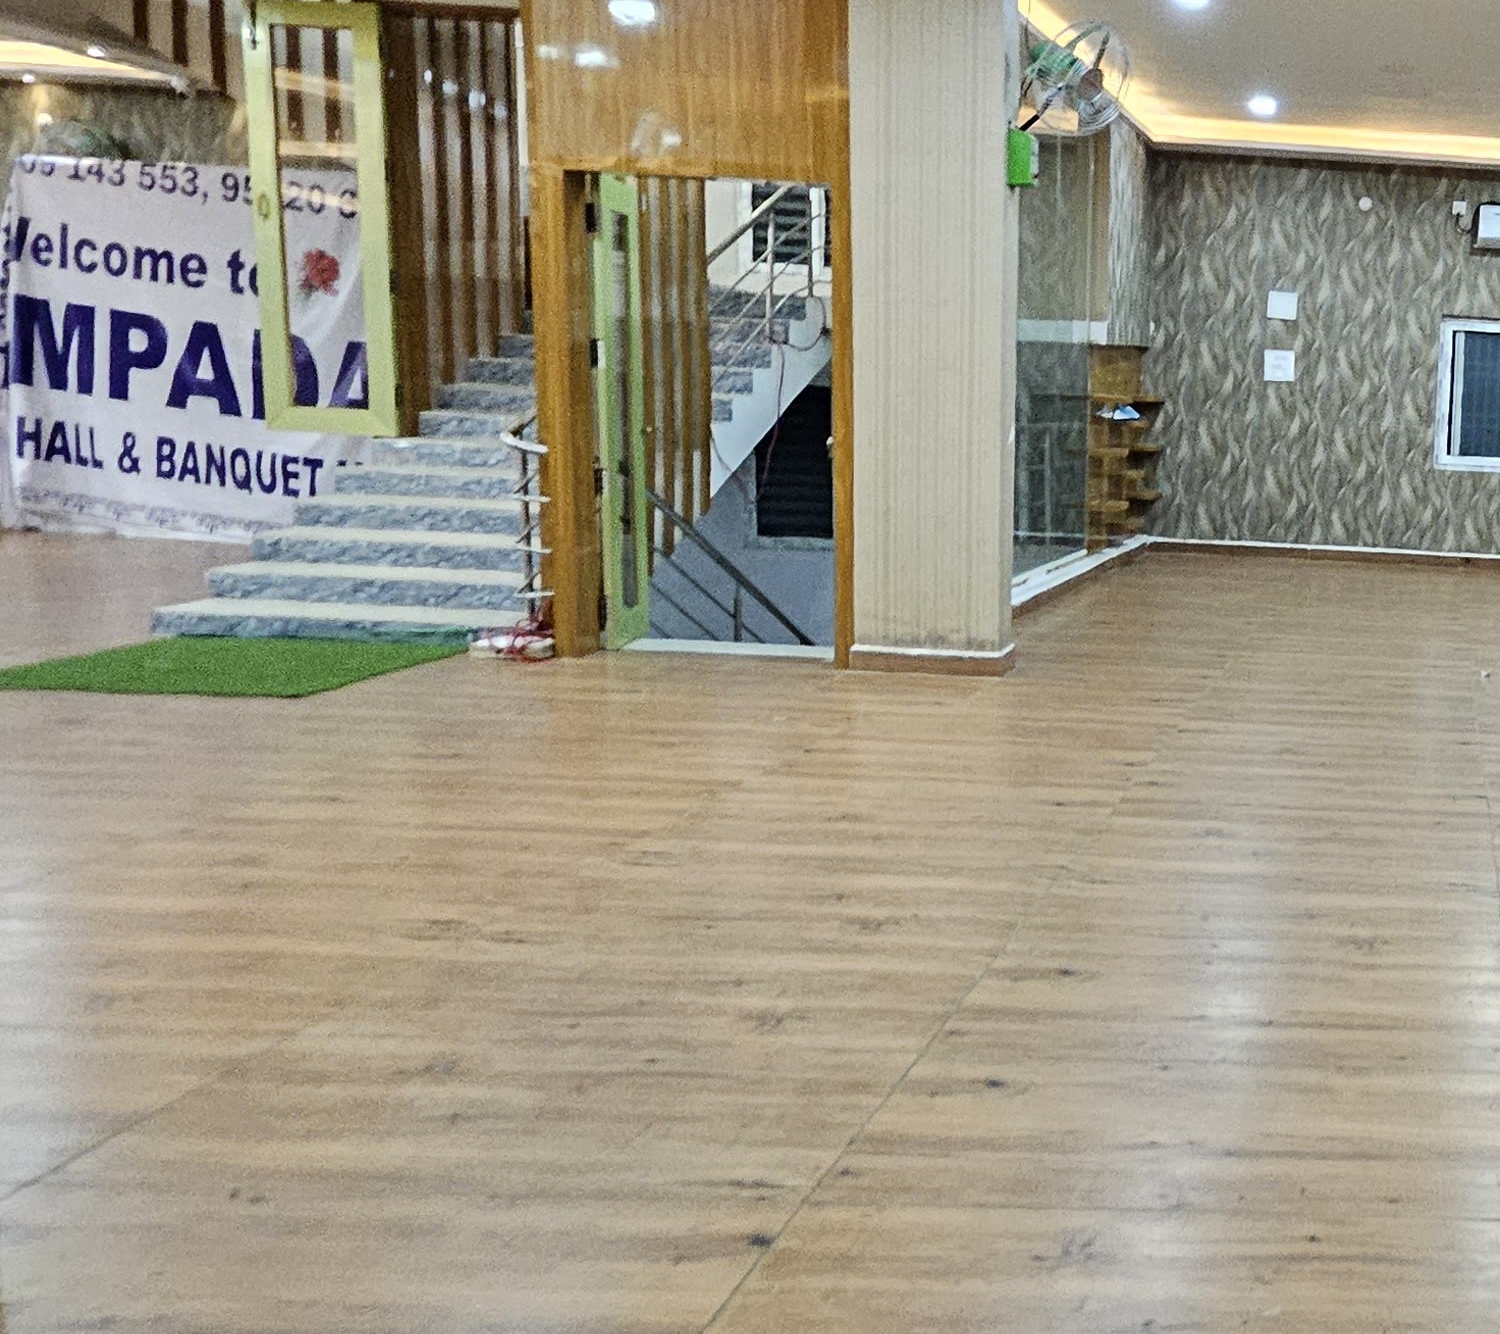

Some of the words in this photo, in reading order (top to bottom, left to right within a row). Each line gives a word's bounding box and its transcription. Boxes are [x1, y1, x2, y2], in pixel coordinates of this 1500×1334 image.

[16, 417, 104, 469] HALL
[117, 430, 141, 475] &
[156, 435, 324, 498] BANQUET
